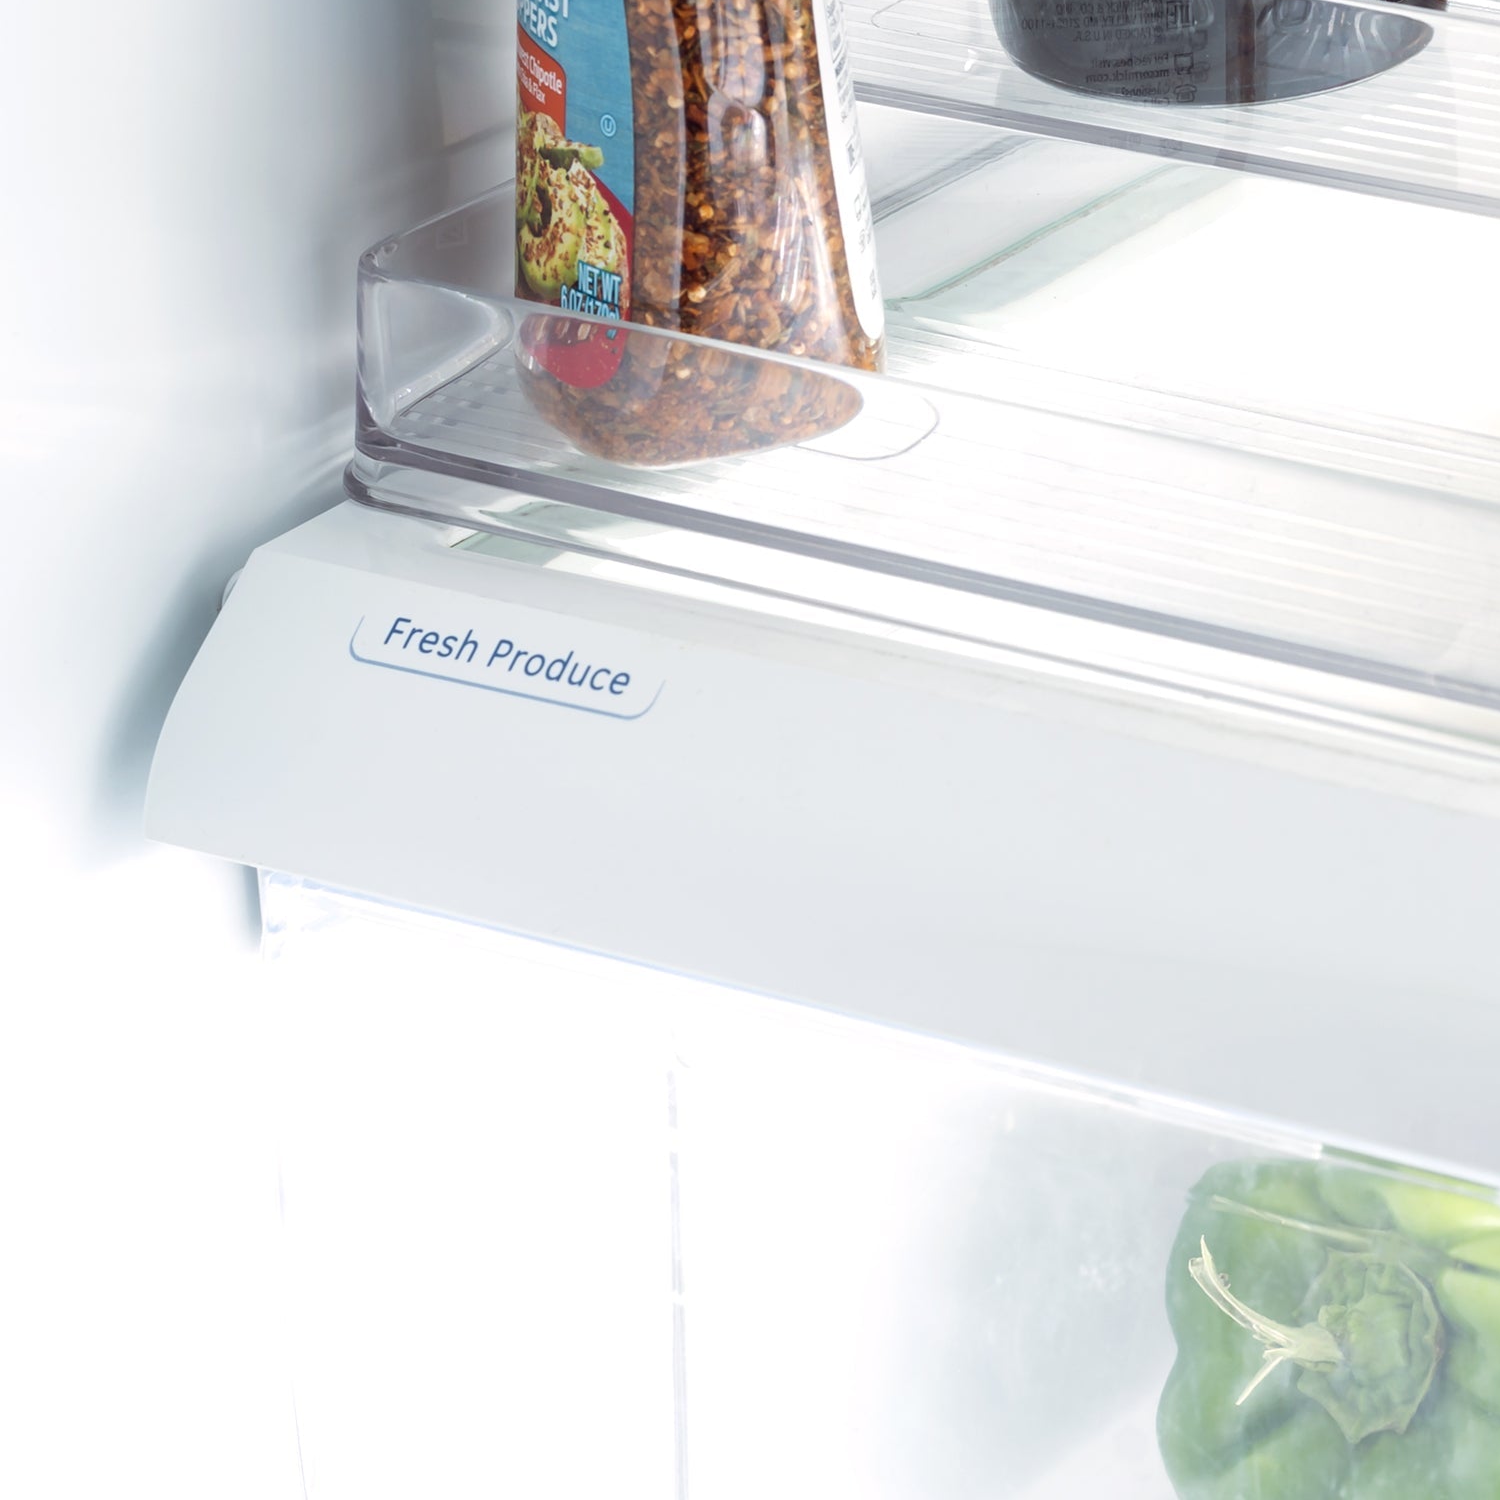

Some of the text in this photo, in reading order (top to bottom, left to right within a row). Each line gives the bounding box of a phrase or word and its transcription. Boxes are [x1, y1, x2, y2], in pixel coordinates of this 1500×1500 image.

[530, 54, 563, 96] Chipotle
[578, 262, 622, 305] NET WT
[383, 617, 631, 696] Fresh Produce
